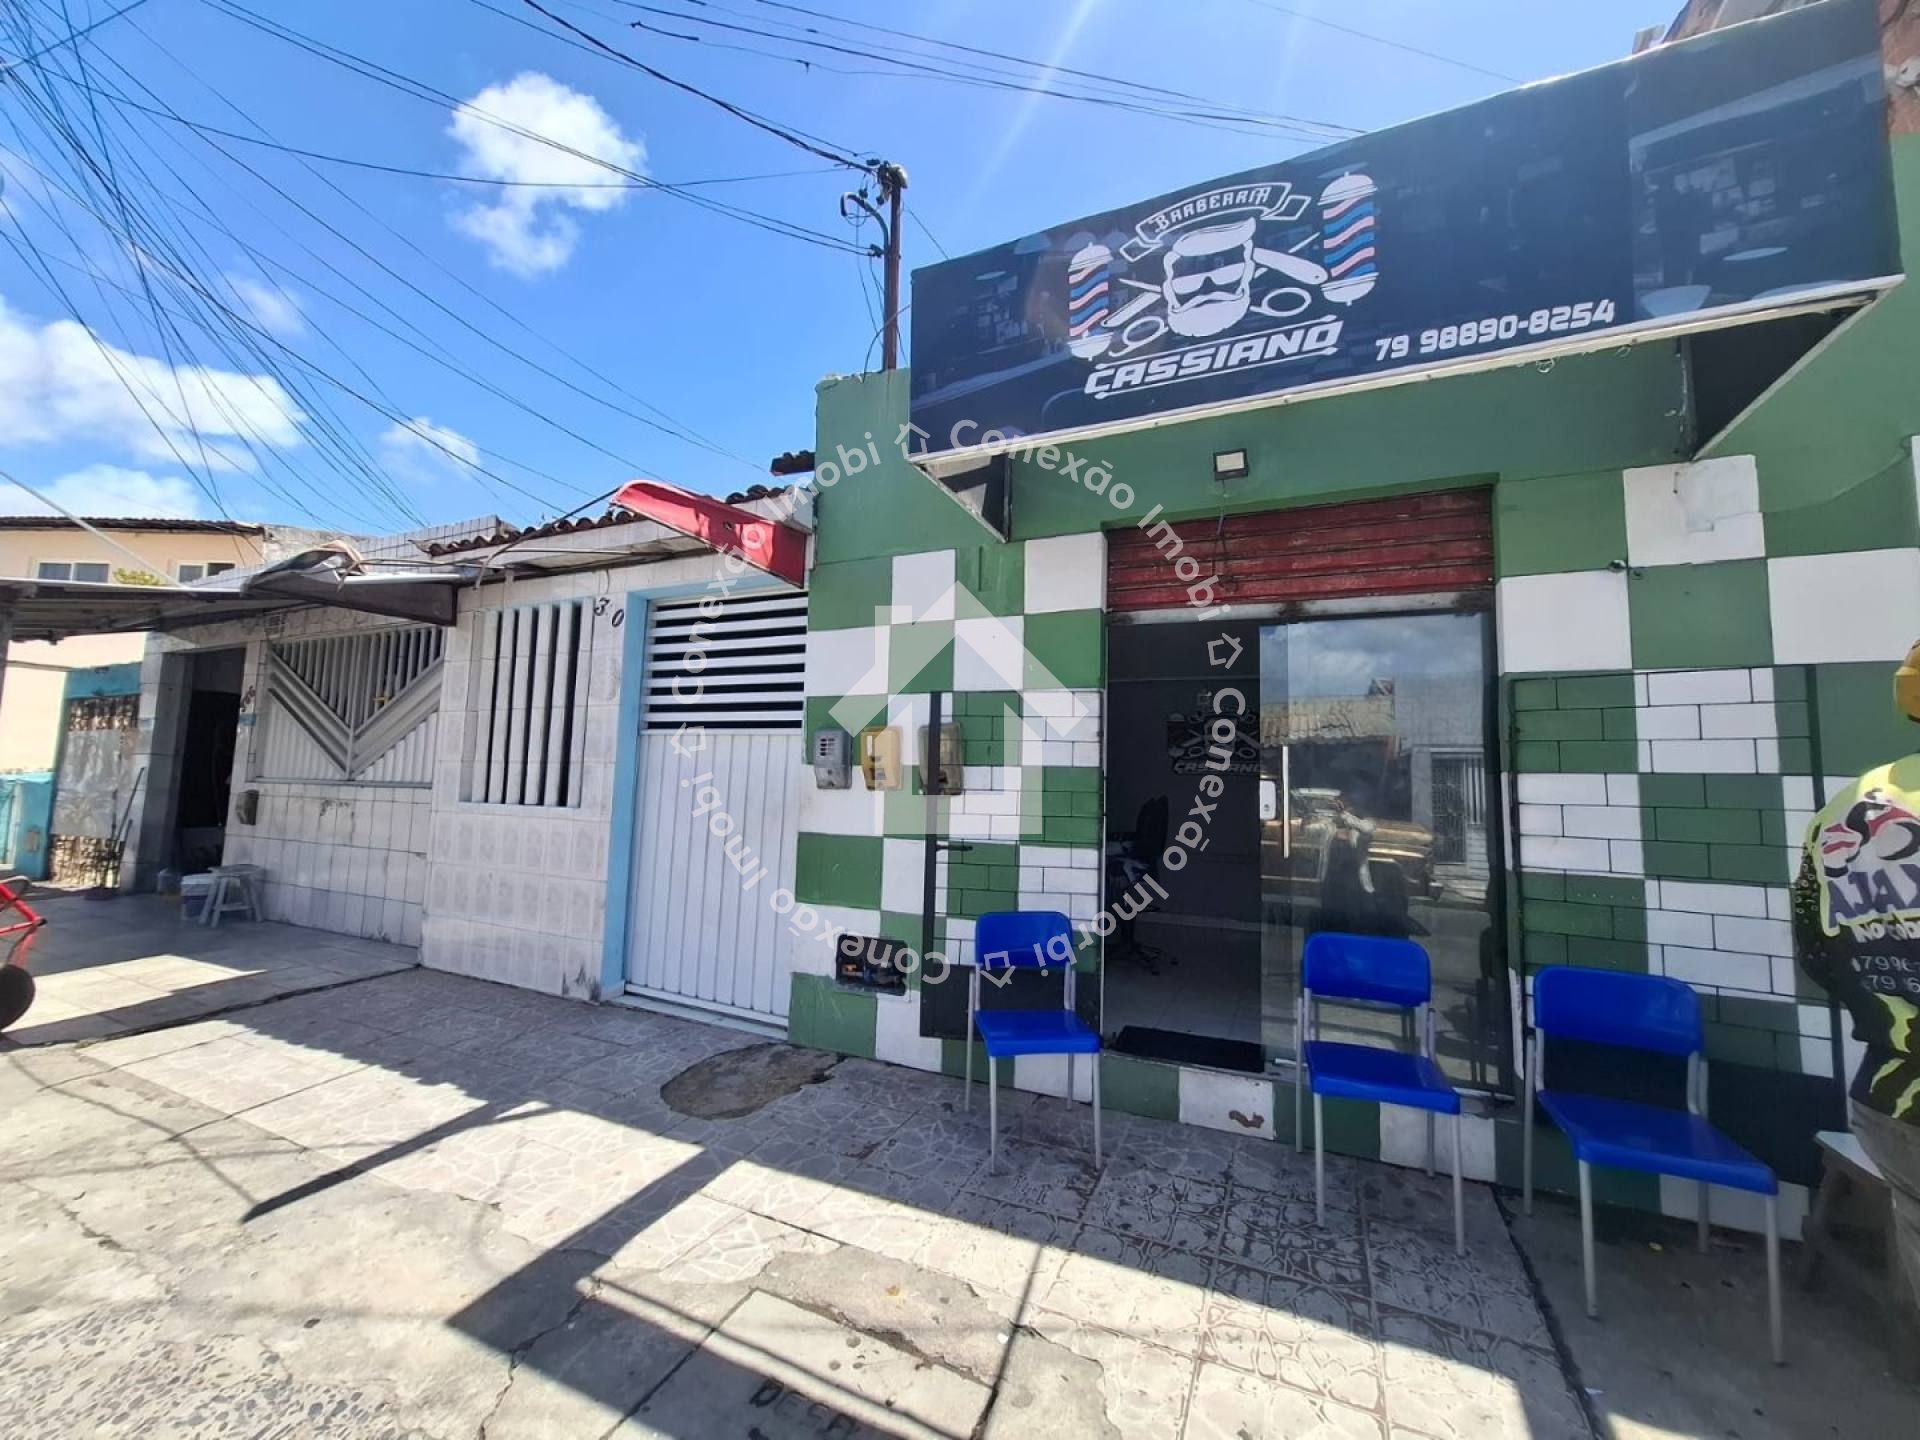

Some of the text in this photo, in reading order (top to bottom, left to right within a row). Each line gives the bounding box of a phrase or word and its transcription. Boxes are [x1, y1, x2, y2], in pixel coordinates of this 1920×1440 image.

[1084, 320, 1344, 394] CASSIANO
[1376, 299, 1615, 361] 79 98890-8254
